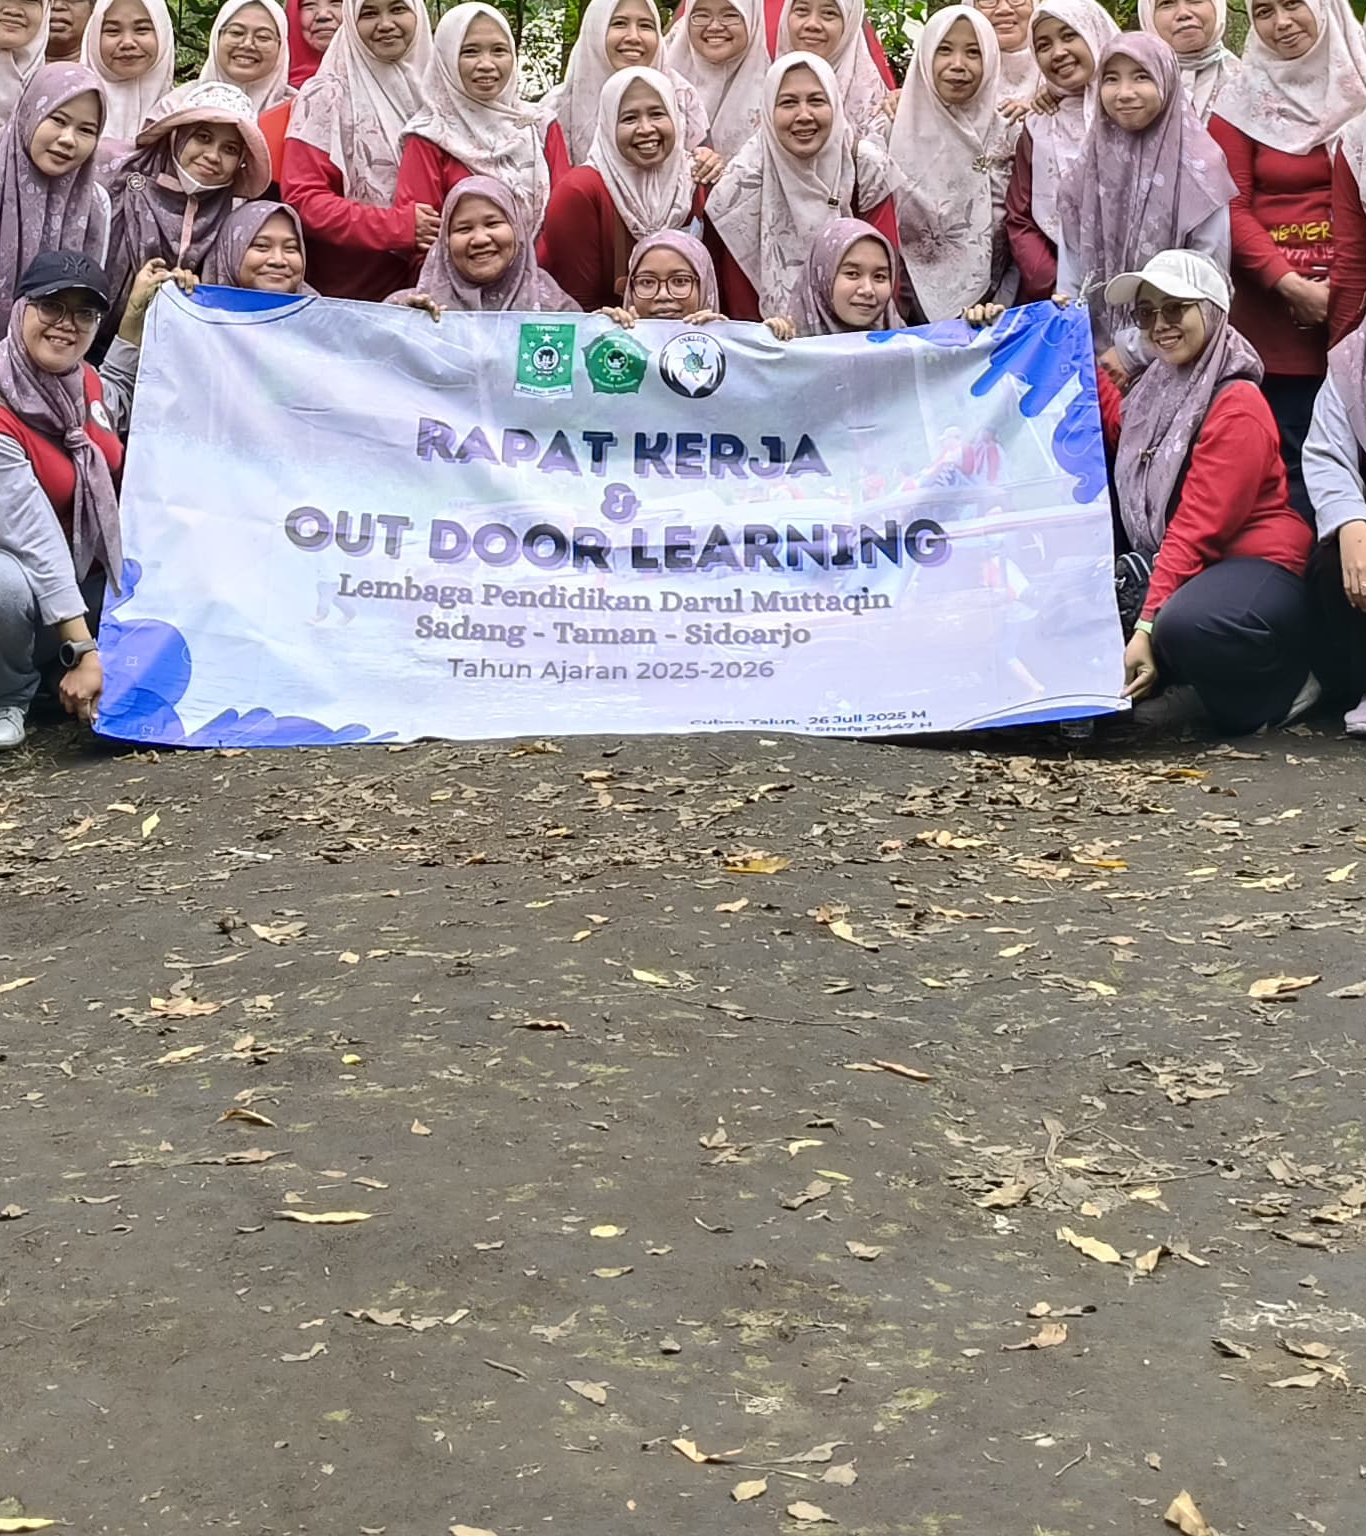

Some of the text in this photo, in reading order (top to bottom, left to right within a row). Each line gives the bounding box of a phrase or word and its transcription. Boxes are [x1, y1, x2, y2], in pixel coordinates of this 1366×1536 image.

[417, 417, 832, 479] RAPAT KERJA
[601, 482, 641, 523] &
[285, 506, 952, 573] OUT DOOR LEARNING
[337, 573, 892, 615] Lembaga Pendidikan Darul Muttaqin
[415, 615, 527, 648] Sadang
[553, 622, 657, 644] Taman
[685, 623, 811, 648] Sidoarjo
[447, 658, 775, 683] Tahun Ajaran 2025-2026
[808, 716, 829, 725] 26
[866, 711, 907, 722] 2025
[911, 710, 927, 719] M
